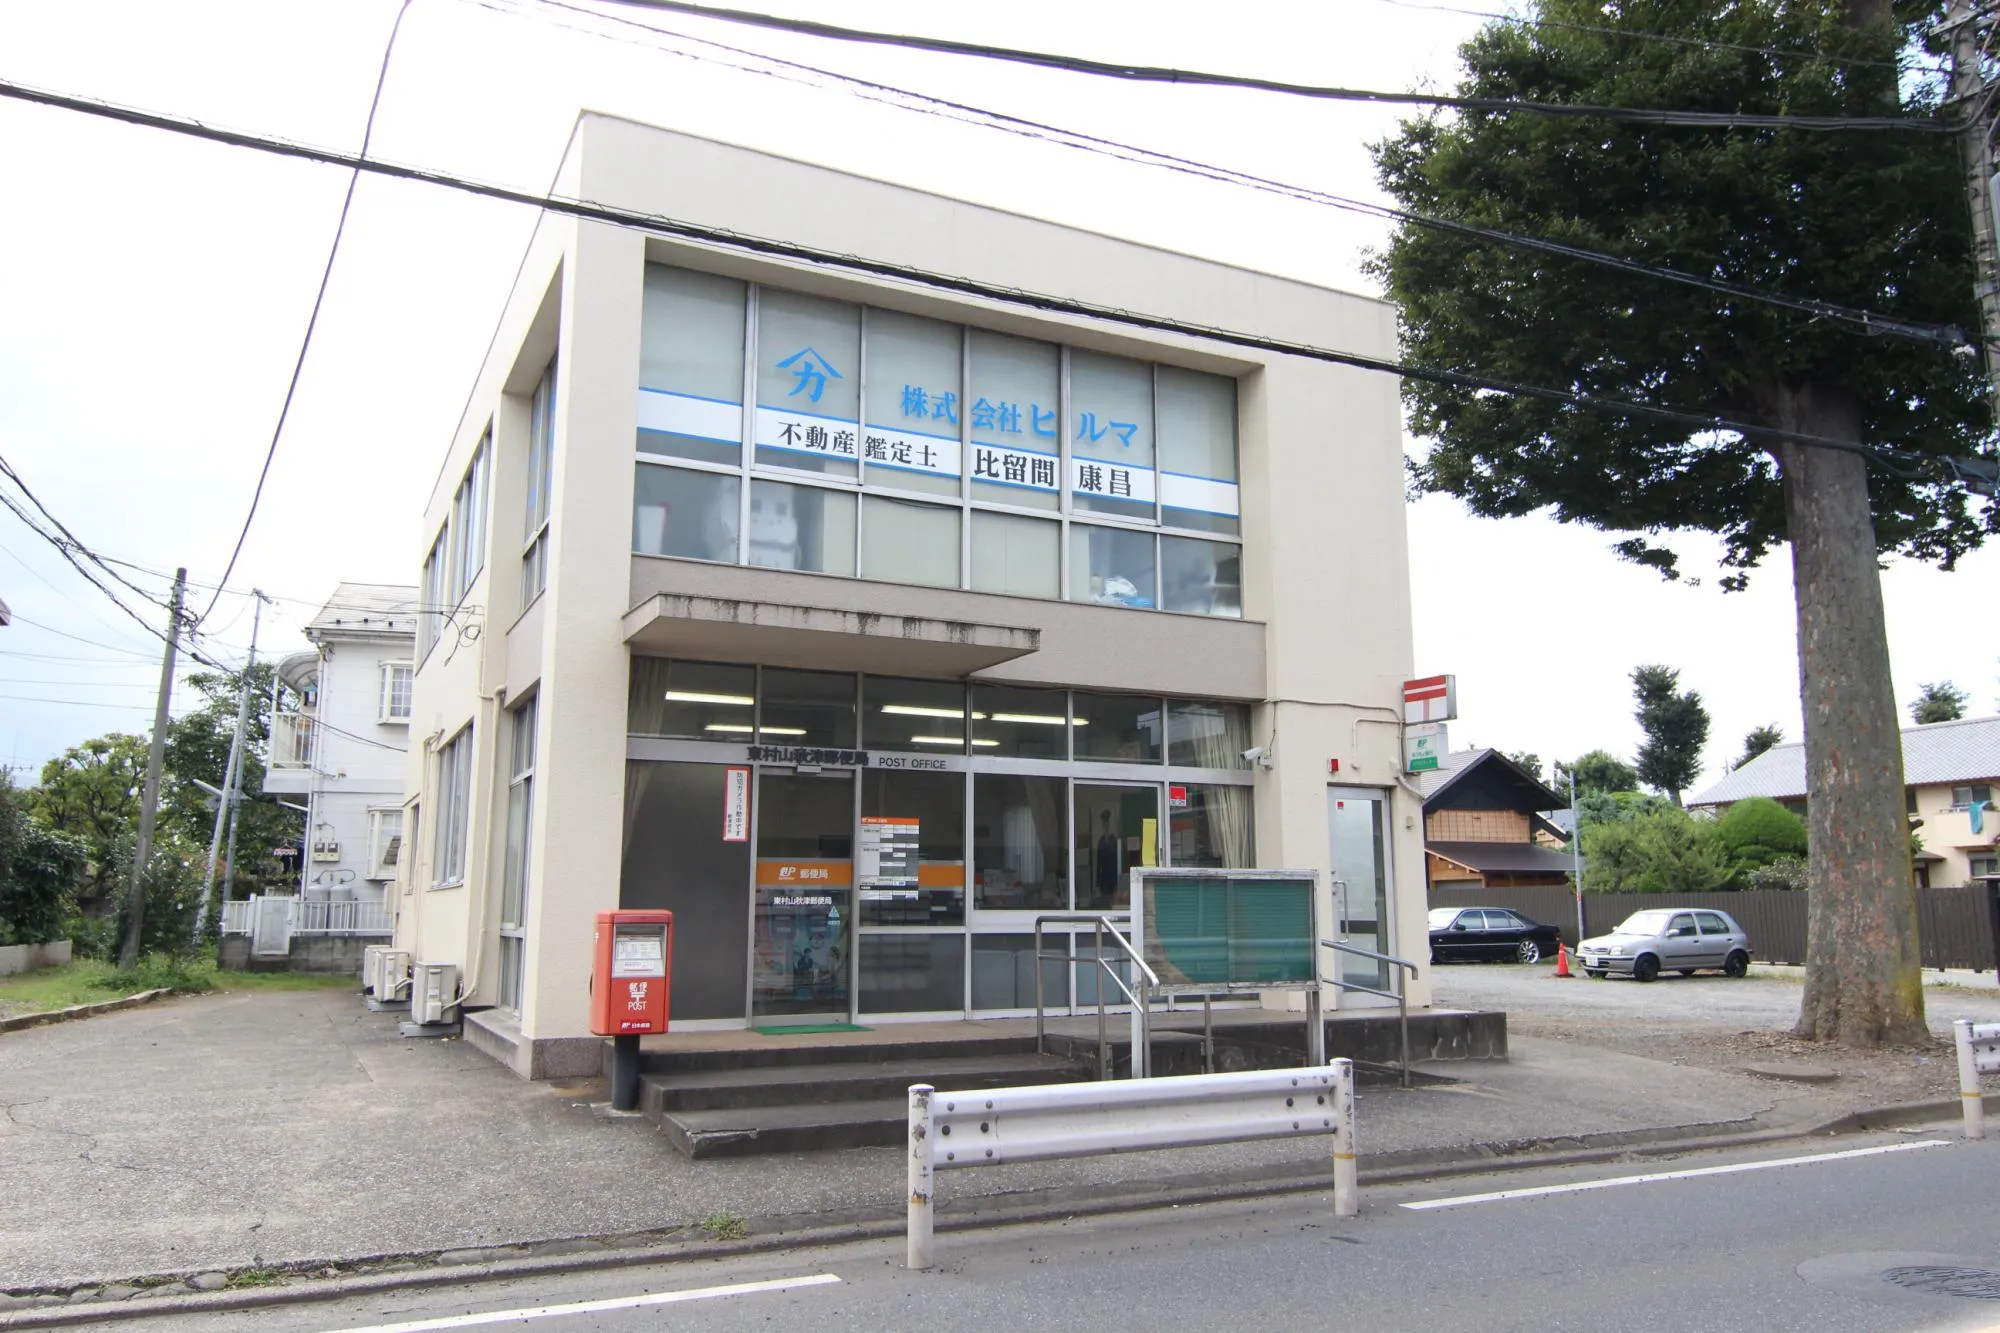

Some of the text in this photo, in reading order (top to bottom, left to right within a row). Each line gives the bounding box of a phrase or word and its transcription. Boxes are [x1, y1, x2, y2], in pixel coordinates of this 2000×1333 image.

[901, 384, 1139, 448] 株式会社ヒルマ
[777, 421, 1132, 497] 不動産鑑定士 比留間 康昌
[747, 746, 870, 767] 東村山秋津郵便局
[879, 757, 947, 769] POST OFFICE
[800, 868, 828, 879] 郵便局
[773, 896, 832, 905] 東村山秋津郵便局
[628, 1001, 647, 1011] POST
